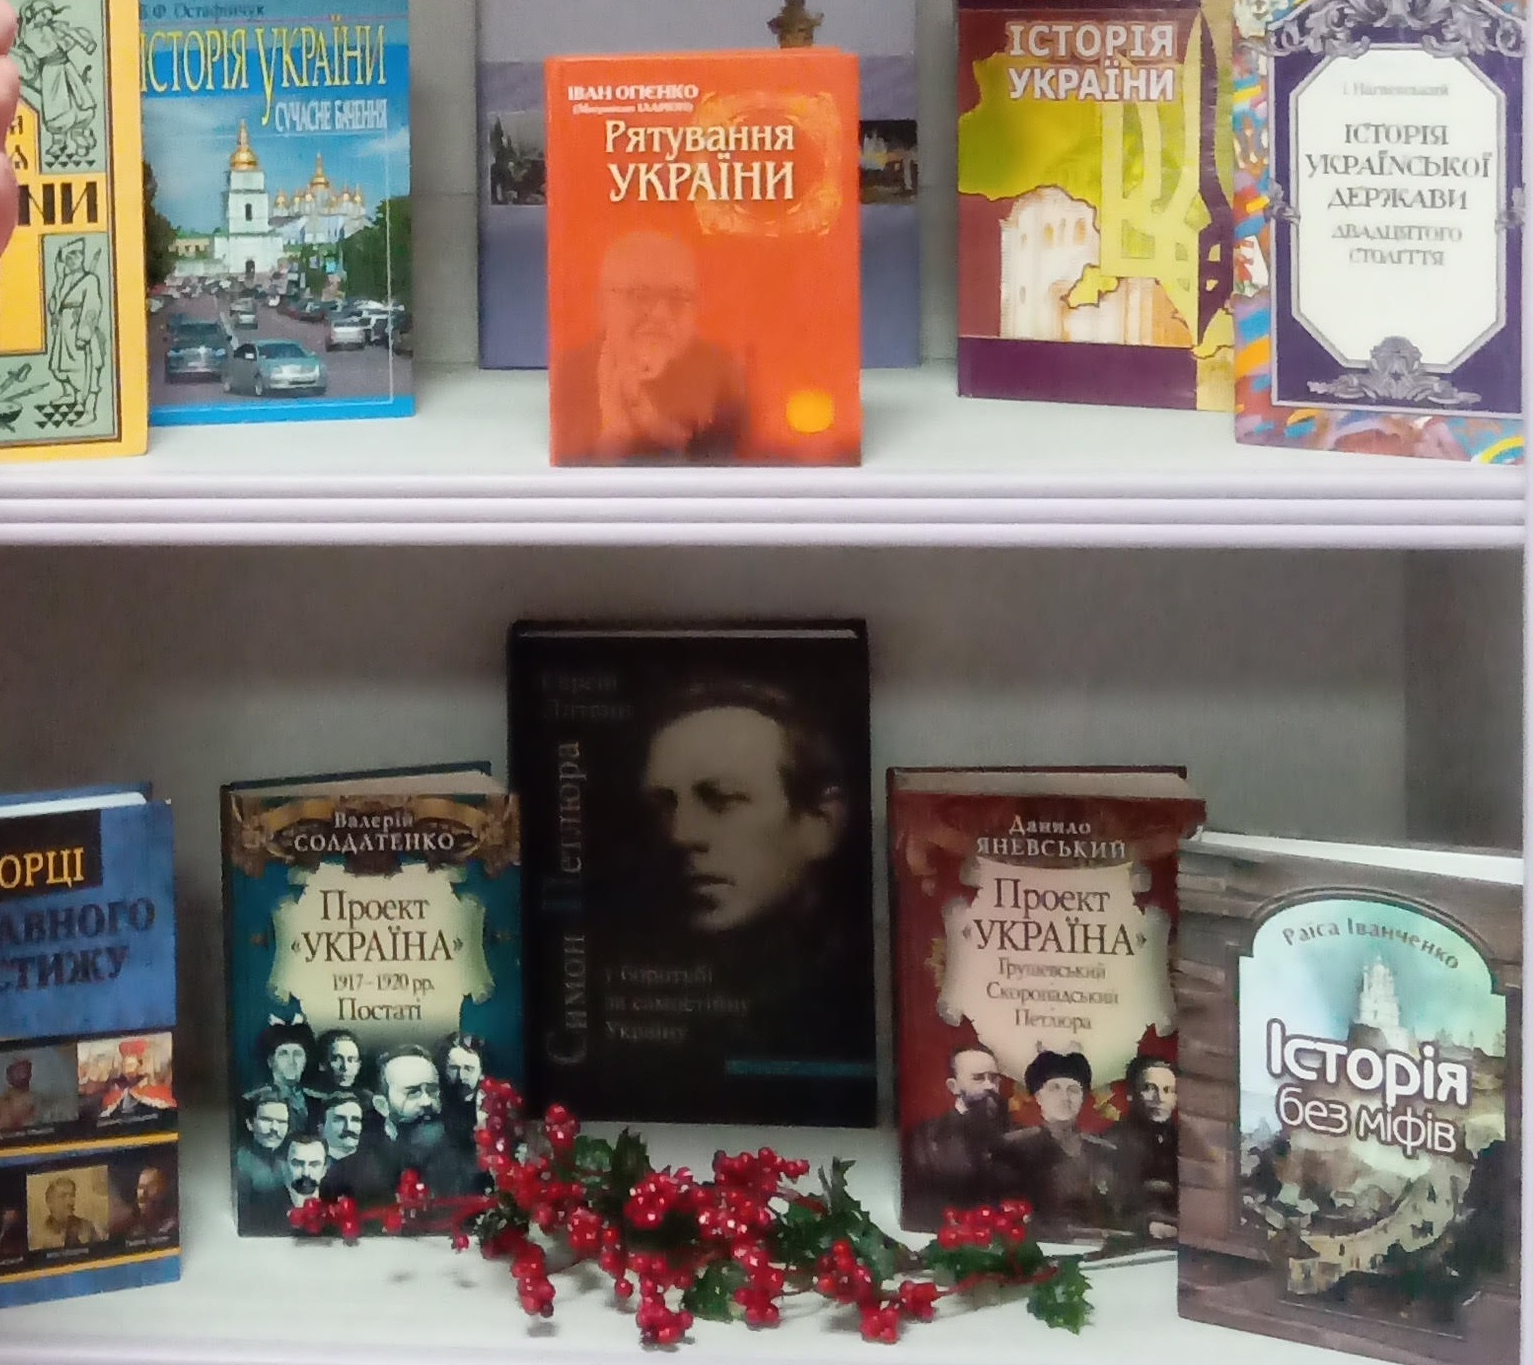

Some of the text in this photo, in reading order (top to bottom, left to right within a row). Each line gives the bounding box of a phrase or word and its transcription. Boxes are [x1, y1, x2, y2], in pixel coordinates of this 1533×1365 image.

[1009, 24, 1175, 57] ІСТОРІЯ
[140, 14, 387, 126] ІСТОРІЯ УКРАЇНИ
[1008, 59, 1174, 101] УКРАЇНИ
[568, 85, 612, 101] ІВАН
[275, 98, 388, 132] СУЧАСНЕ БАЧЕННЯ
[605, 120, 795, 161] Рятування
[1344, 123, 1450, 146] ІСТОРІЯ
[607, 152, 794, 203] УКРАЇНИ
[1305, 150, 1493, 179] УКРАЇНСЬКОЇ
[1327, 186, 1468, 210] ДЕРЖАВИ
[334, 810, 414, 831] Валерій
[1008, 814, 1091, 835] Данило
[294, 833, 454, 855] СОЛДАТЕНКО
[976, 836, 1126, 859] ЯНЕВСЬКИЙ
[319, 889, 430, 929] Проект
[994, 878, 1110, 919] Проект
[291, 925, 464, 963] «УКРАЇНА»
[962, 916, 1147, 956] «УКРАЇНА»
[1282, 917, 1459, 969] Раїса Іванченко
[999, 958, 1106, 980] Грушевський
[338, 997, 422, 1021] Постаті
[986, 982, 1118, 1006] Скоропадський
[1015, 1008, 1092, 1034] Петлюра
[1270, 1022, 1468, 1107] Історія
[1280, 1086, 1457, 1155] без міфів
